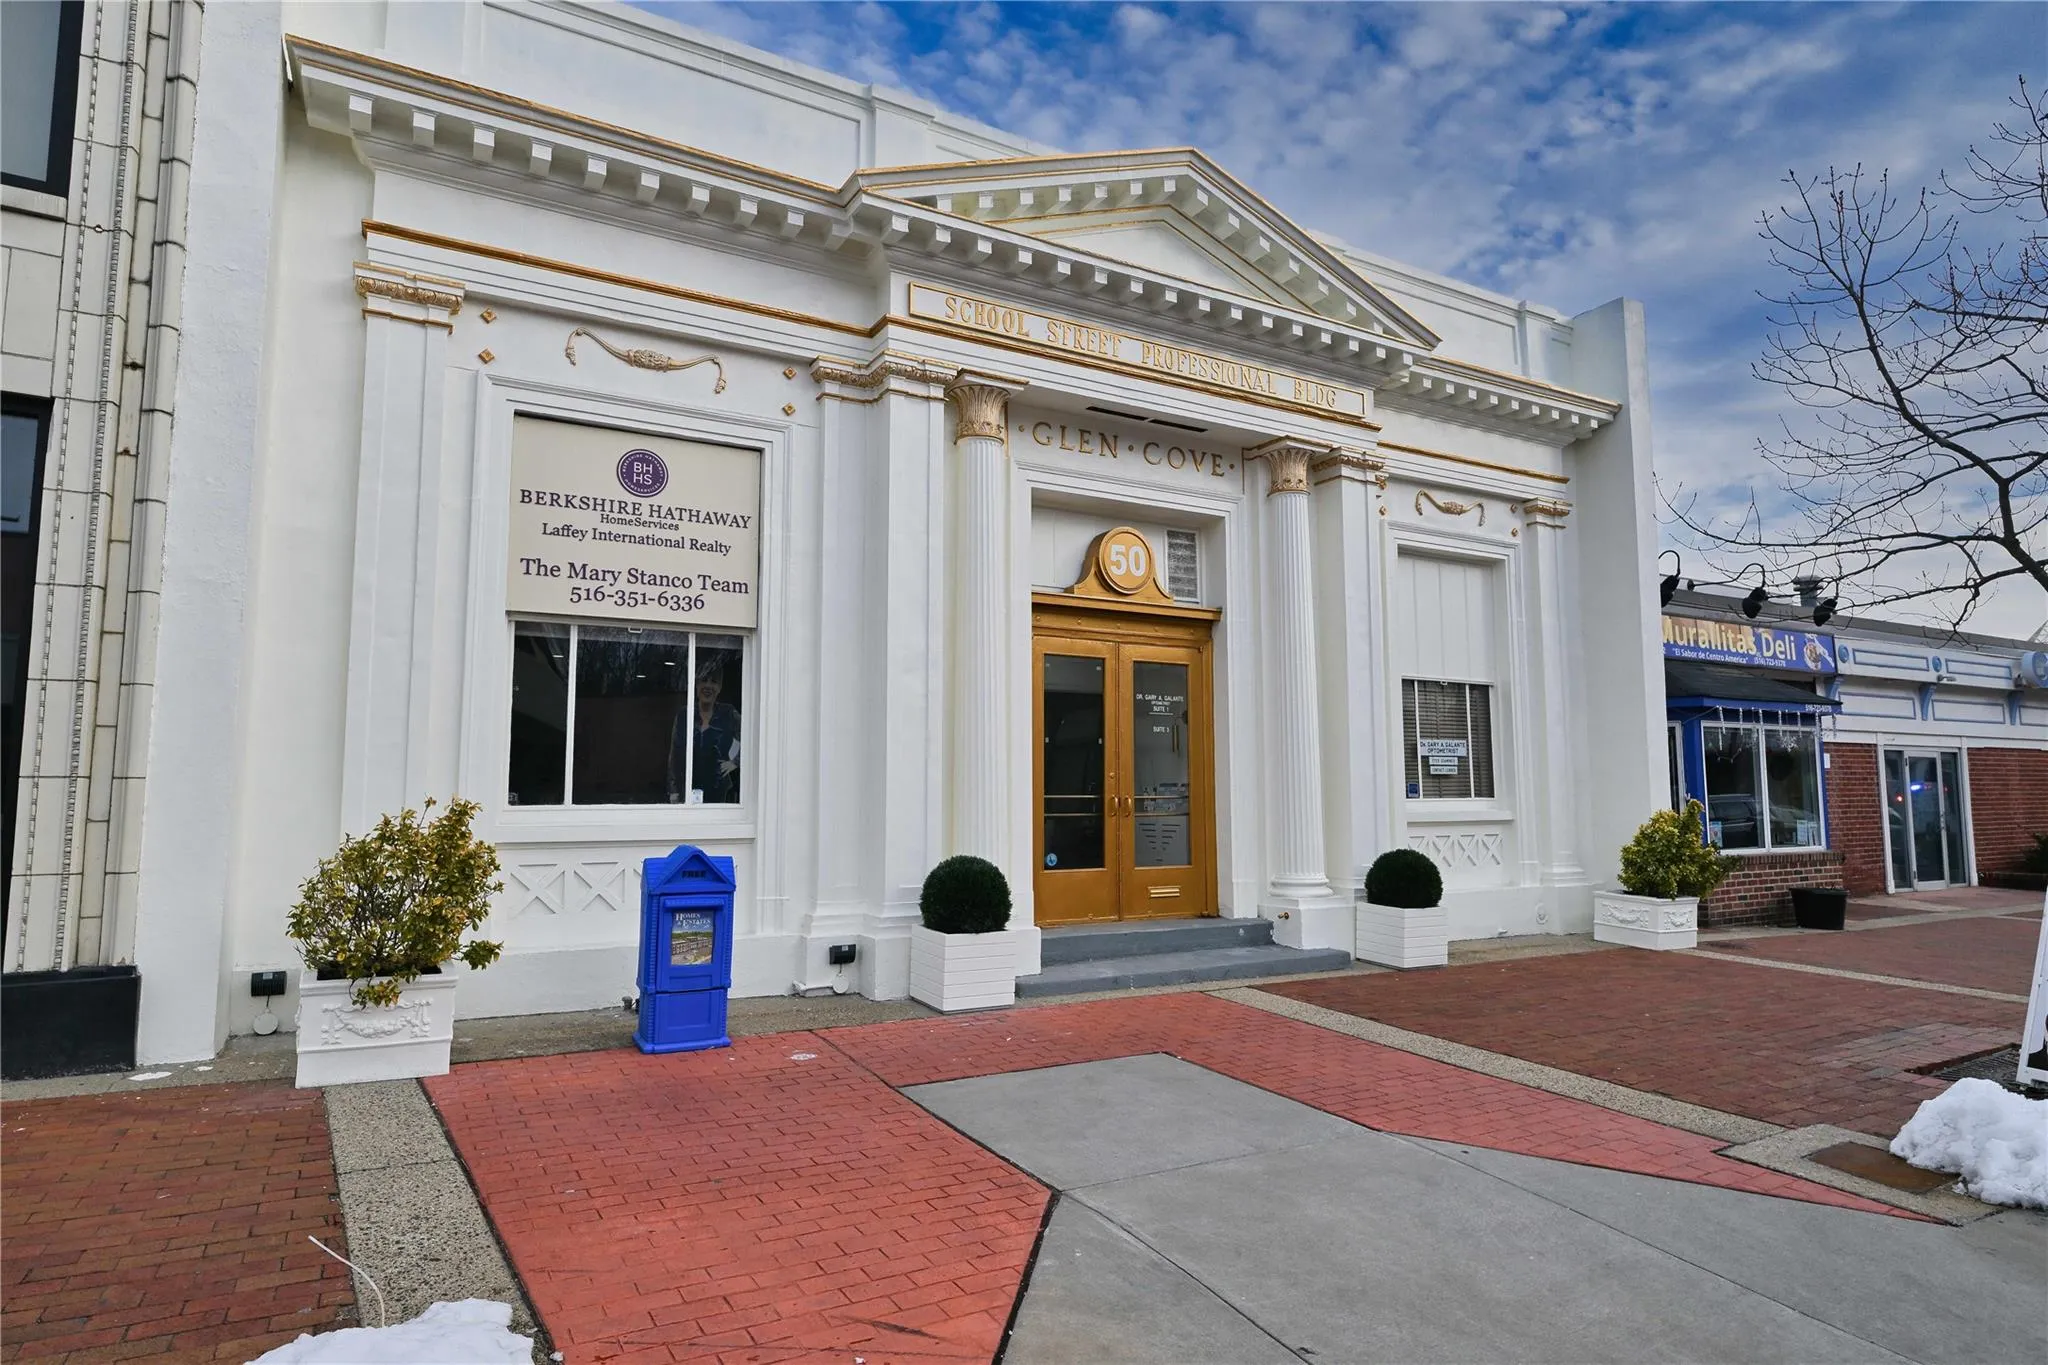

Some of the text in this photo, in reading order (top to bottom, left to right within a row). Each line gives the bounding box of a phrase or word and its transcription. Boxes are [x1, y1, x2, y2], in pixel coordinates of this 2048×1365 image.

[945, 296, 1335, 408] SCHOOL STREET PROFESSIONAL BLDG
[1032, 421, 1225, 477] GLEN COVE
[633, 462, 653, 474] BH
[633, 473, 653, 485] HS
[520, 489, 751, 529] BERKSHIRE HATHAWAY
[600, 514, 680, 531] HomeServices
[542, 523, 731, 556] Laffey International Realty
[1110, 544, 1147, 577] 50
[520, 558, 749, 594] The Mary Stanco Team
[569, 585, 705, 612] 516-351-6336
[1706, 652, 1724, 661] Centro
[1762, 632, 1796, 660] Deli
